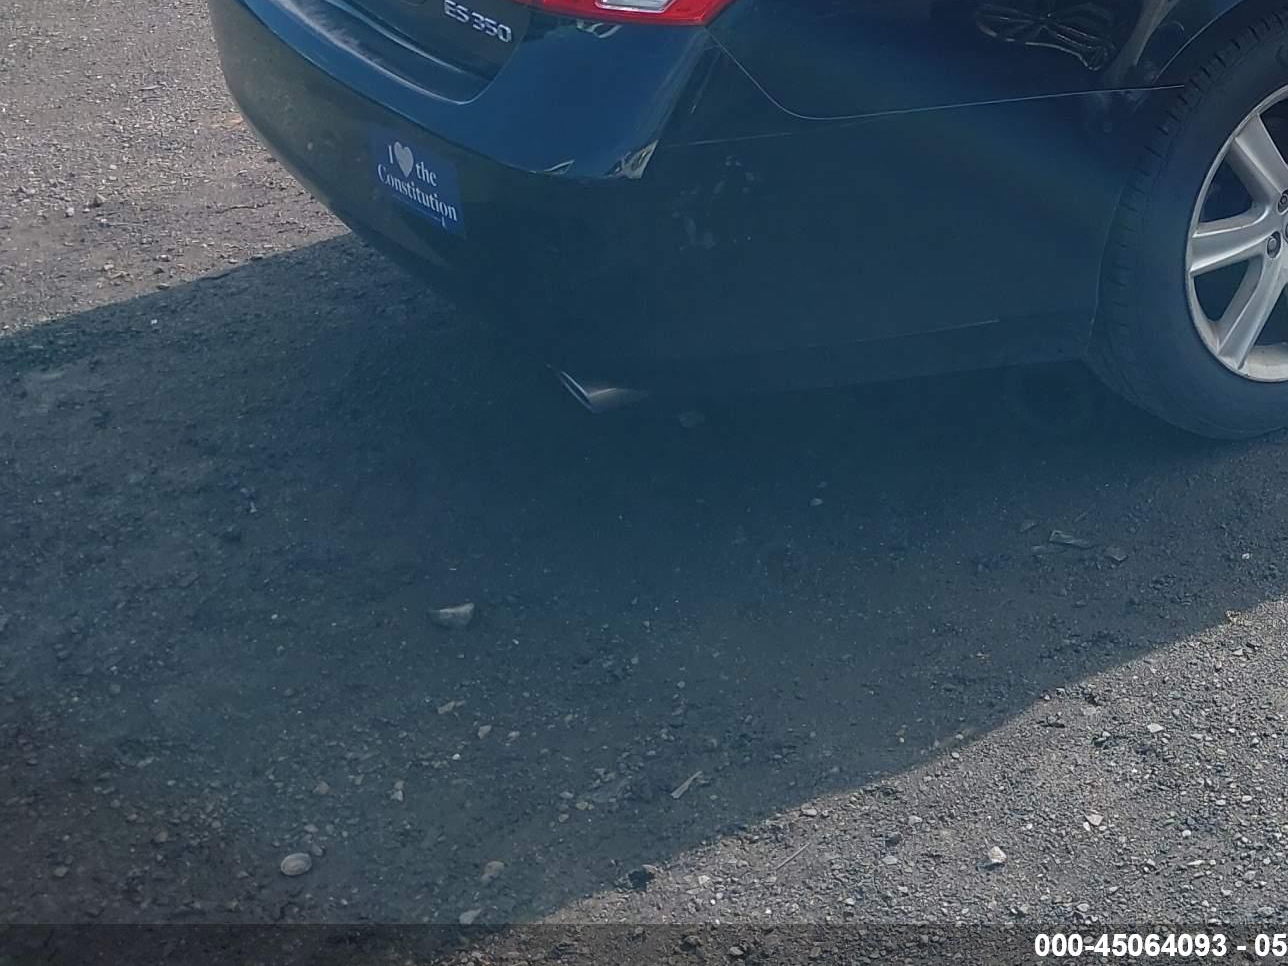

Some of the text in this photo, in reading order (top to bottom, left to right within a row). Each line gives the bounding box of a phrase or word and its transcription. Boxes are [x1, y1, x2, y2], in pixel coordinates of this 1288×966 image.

[471, 11, 512, 43] 350
[388, 145, 437, 186] I the
[377, 163, 457, 221] Constitution
